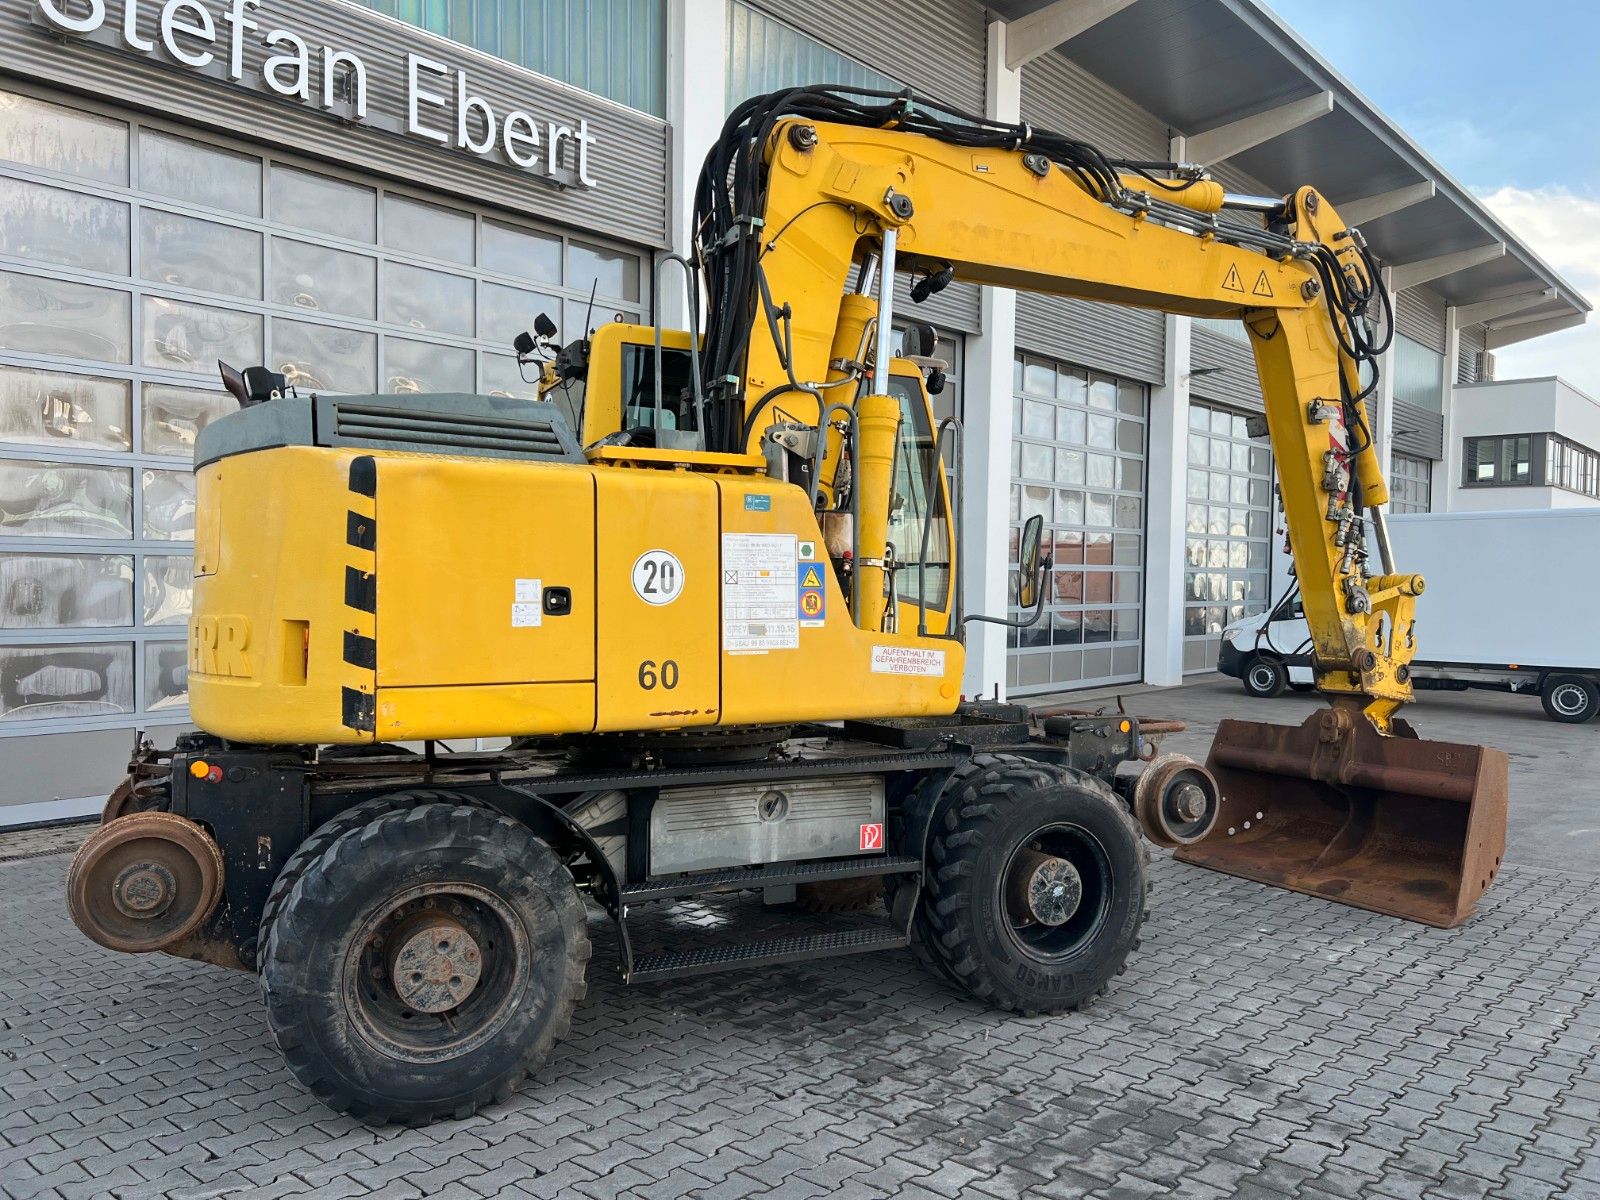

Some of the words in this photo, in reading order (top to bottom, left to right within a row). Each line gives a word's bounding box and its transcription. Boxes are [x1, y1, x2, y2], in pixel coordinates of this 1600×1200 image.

[407, 52, 597, 188] Ebert
[643, 560, 674, 594] 20
[875, 655, 941, 666] GEFAHRENBEREICH
[882, 648, 925, 658] AUFENTHALT
[927, 651, 935, 659] IM
[638, 660, 678, 690] 60
[889, 664, 926, 673] VERBOTEN
